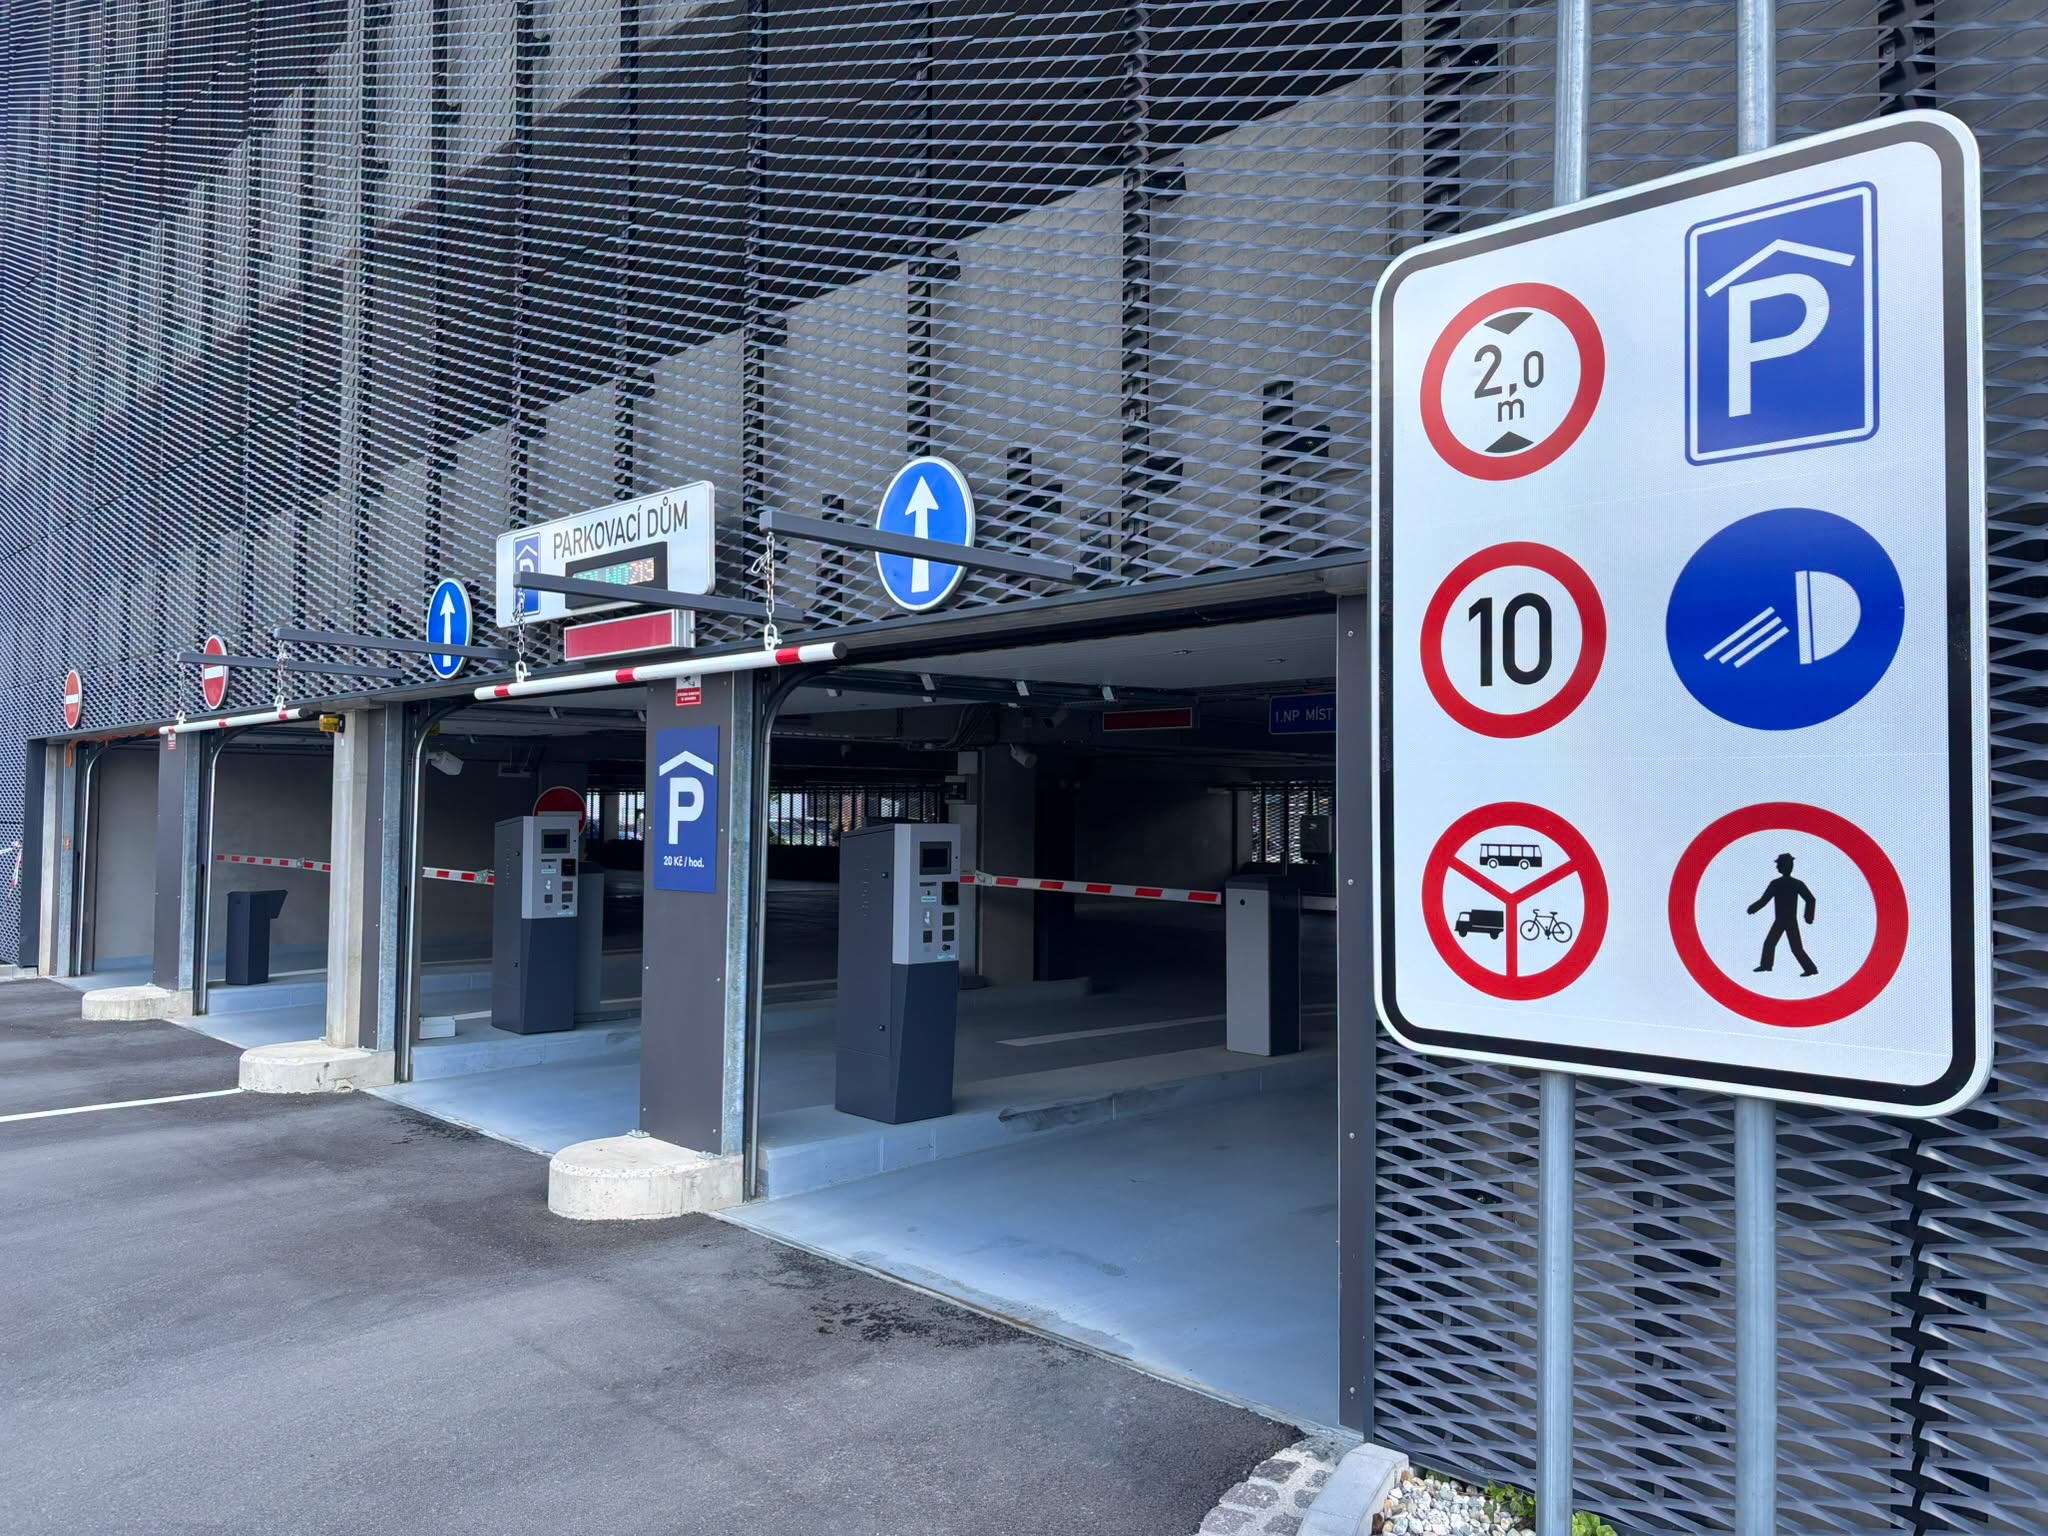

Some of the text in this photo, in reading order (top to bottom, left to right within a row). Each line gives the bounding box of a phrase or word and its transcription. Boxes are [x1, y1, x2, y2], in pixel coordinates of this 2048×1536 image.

[1474, 344, 1544, 399] 2,0
[1728, 273, 1830, 418] P
[1497, 398, 1525, 422] m
[553, 496, 688, 560] PARKOVACÍ DŮM
[1468, 592, 1553, 687] 10
[668, 776, 705, 845] P
[663, 855, 673, 866] 20
[673, 855, 683, 867] Kč
[688, 856, 705, 868] hod.
